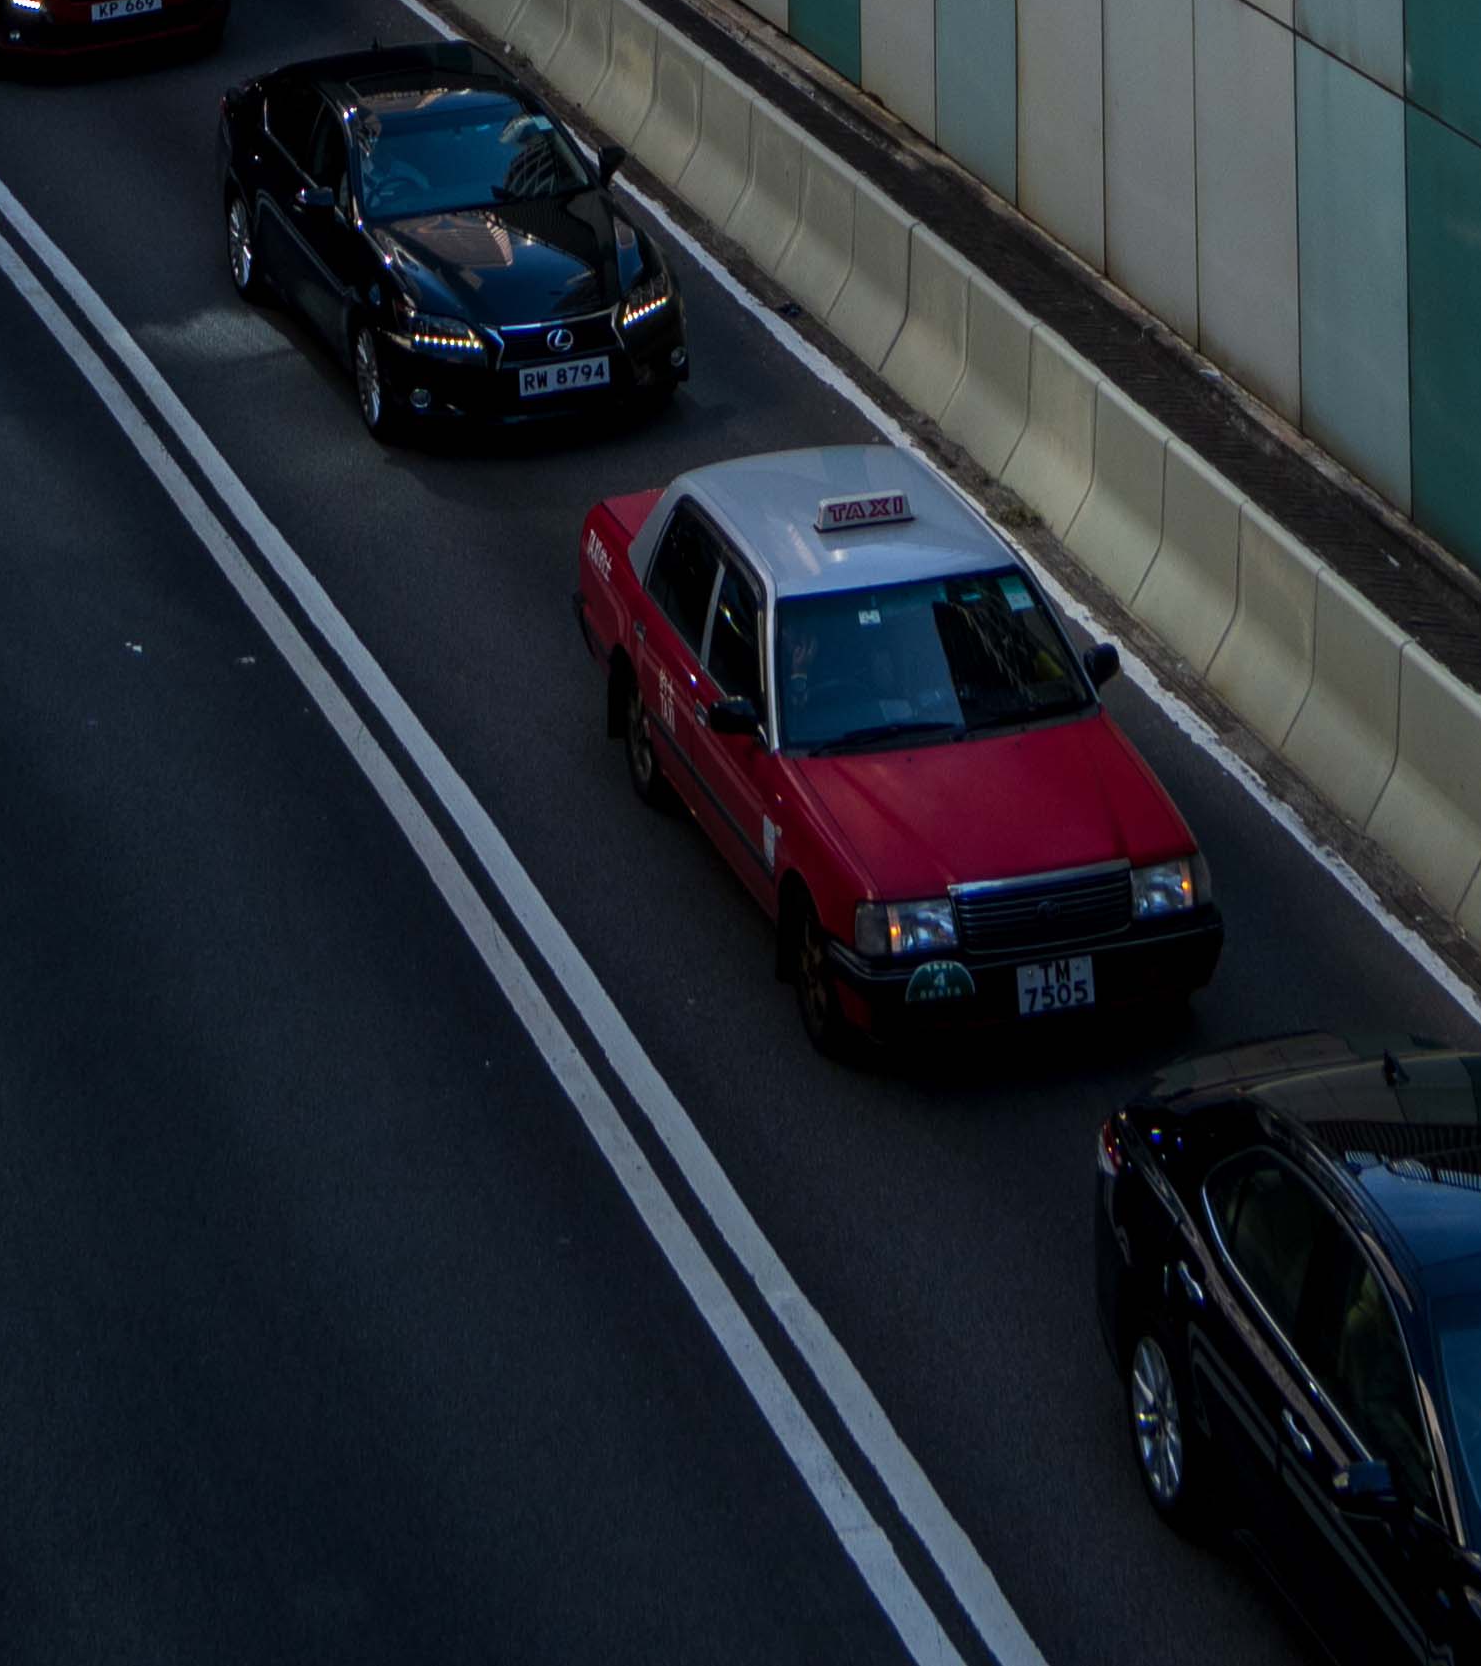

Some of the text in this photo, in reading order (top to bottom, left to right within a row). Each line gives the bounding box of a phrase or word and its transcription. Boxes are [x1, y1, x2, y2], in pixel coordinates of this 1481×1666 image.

[99, 2, 118, 18] KP
[524, 362, 604, 391] RW 8794
[828, 495, 904, 522] TAXI
[934, 972, 946, 987] 4
[1039, 960, 1070, 986] TM
[1025, 980, 1088, 1013] 7505
